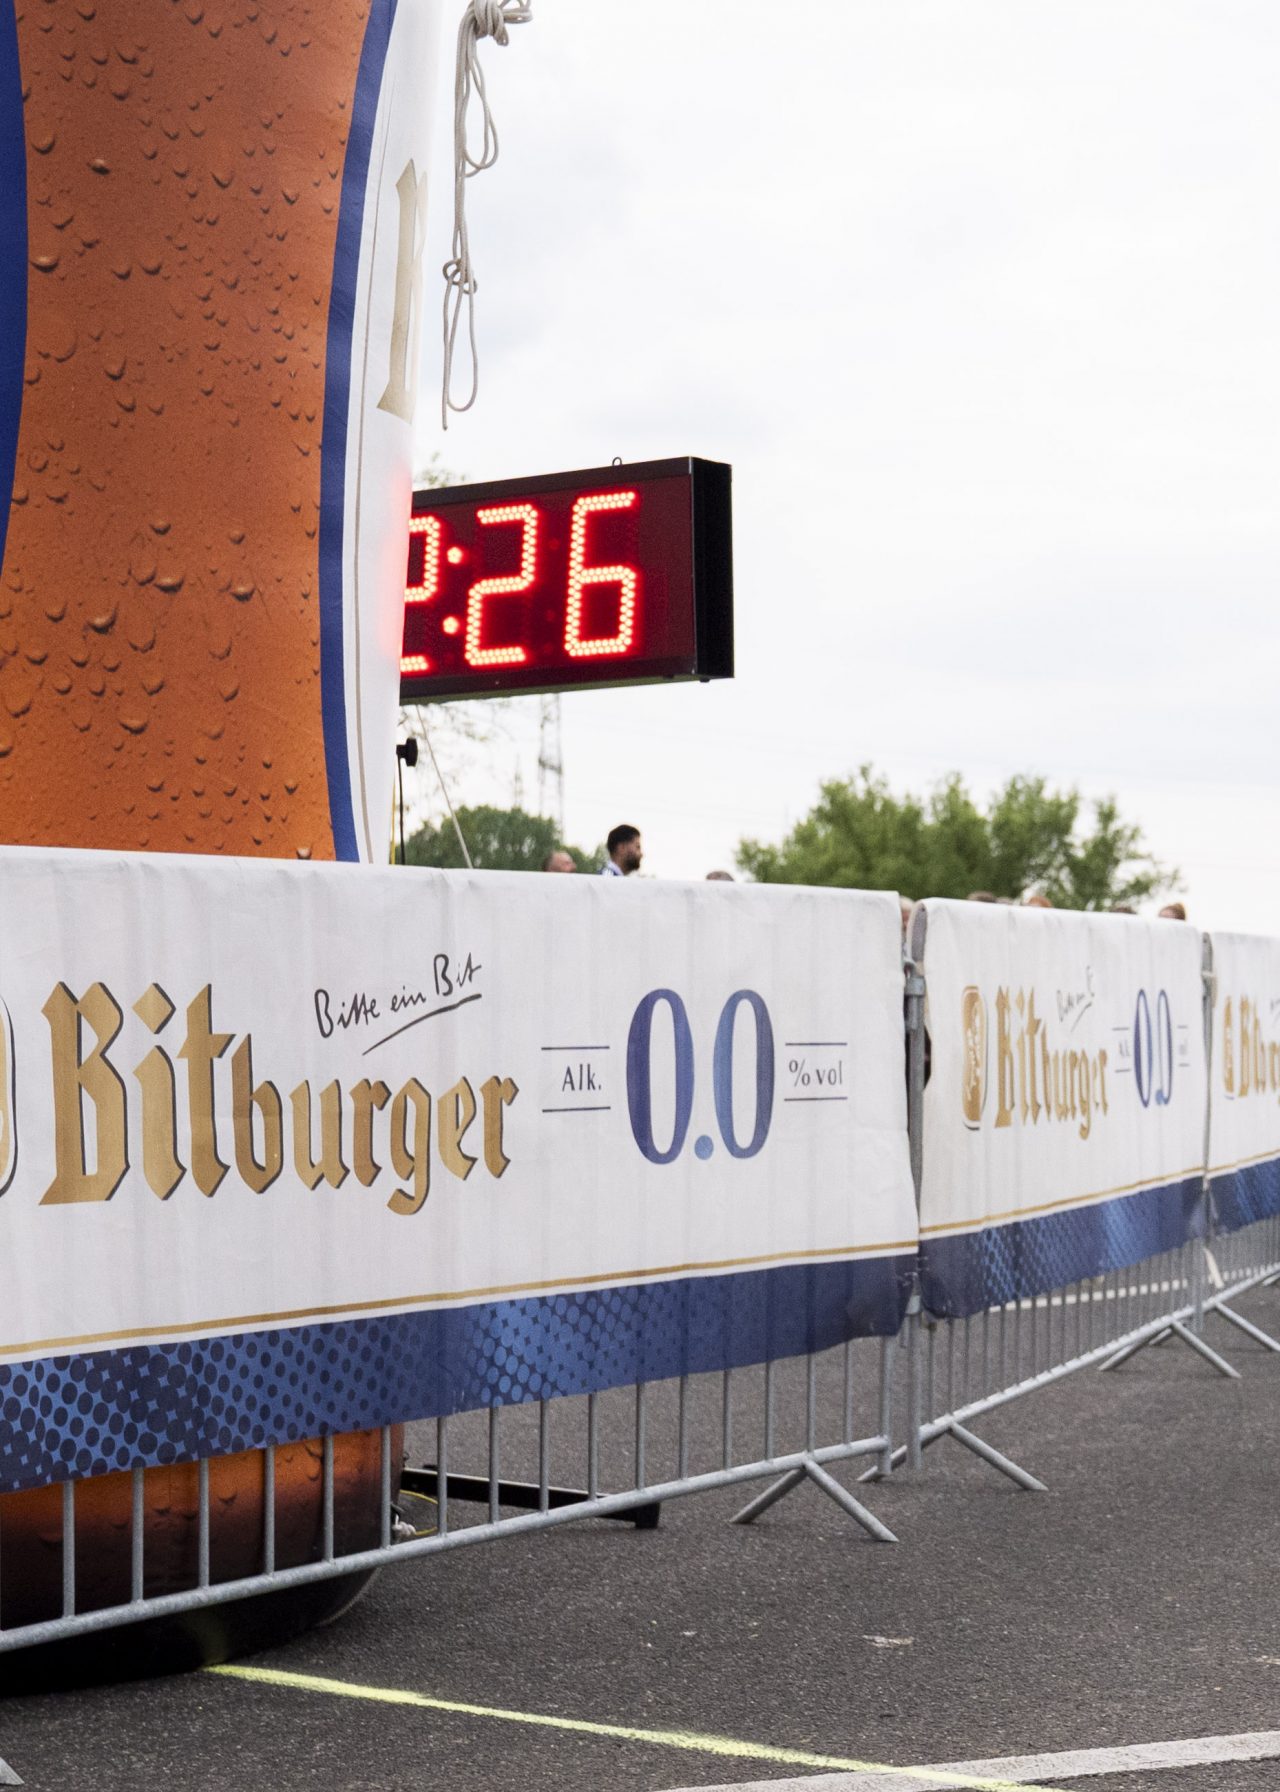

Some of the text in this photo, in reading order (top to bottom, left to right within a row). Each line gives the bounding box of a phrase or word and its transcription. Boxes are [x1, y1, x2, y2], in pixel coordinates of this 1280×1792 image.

[314, 952, 482, 1038] Bitte ein Bit
[562, 1063, 602, 1092] Alk.
[626, 988, 775, 1165] 0.0
[994, 985, 1108, 1140] Bitburger
[38, 981, 520, 1216] Bitburger
